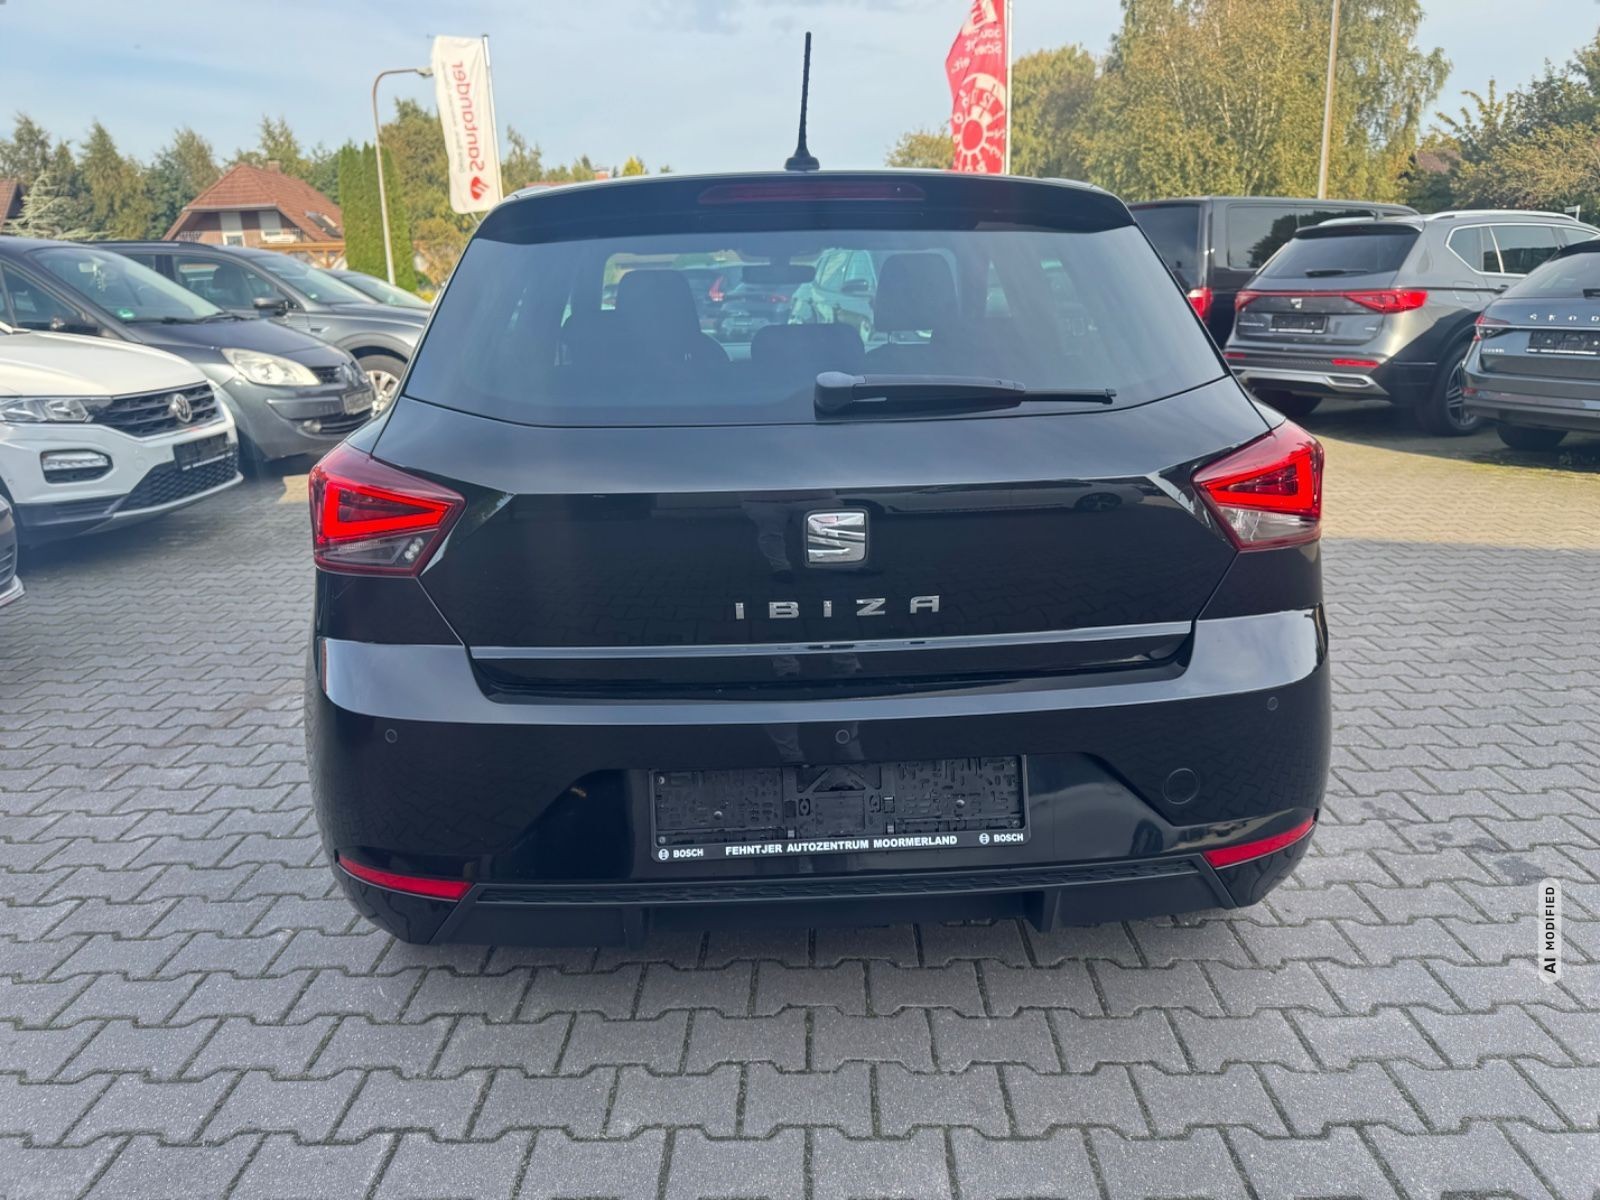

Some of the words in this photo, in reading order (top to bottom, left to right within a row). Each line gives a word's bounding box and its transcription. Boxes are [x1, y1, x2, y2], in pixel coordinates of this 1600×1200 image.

[735, 595, 940, 620] IBIZA
[673, 848, 704, 858] BOSCH
[725, 844, 783, 856] FEHNTJER
[786, 839, 869, 853] AUTOZENTRUM
[873, 835, 958, 848] MOORMERLAND
[993, 833, 1024, 842] BOSCH
